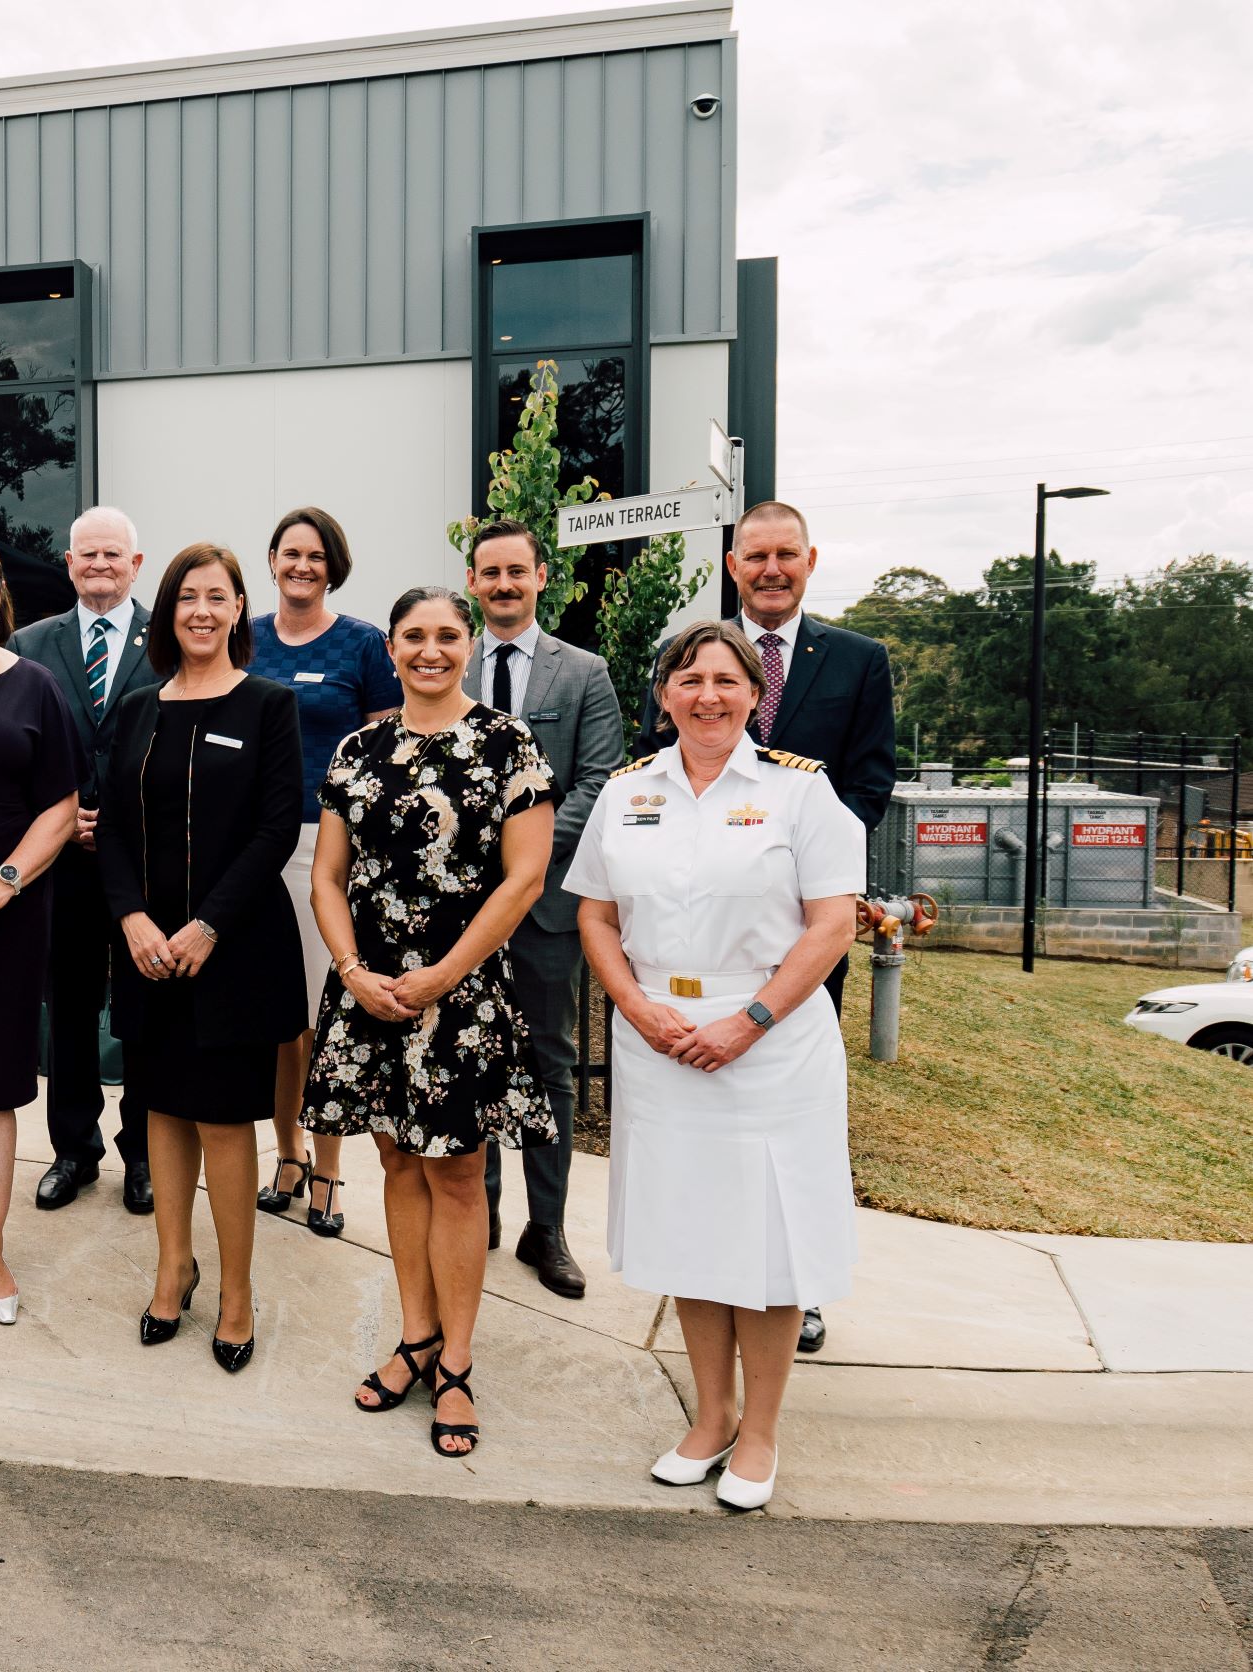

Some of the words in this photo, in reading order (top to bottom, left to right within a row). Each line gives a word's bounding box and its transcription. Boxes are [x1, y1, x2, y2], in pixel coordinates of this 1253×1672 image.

[568, 511, 614, 532] TAIPAN
[619, 501, 681, 524] TERRACE
[926, 825, 978, 833] HYDRANT
[1082, 826, 1136, 835] HYDRANT
[920, 833, 952, 842] WATER
[1076, 835, 1110, 843] WATER
